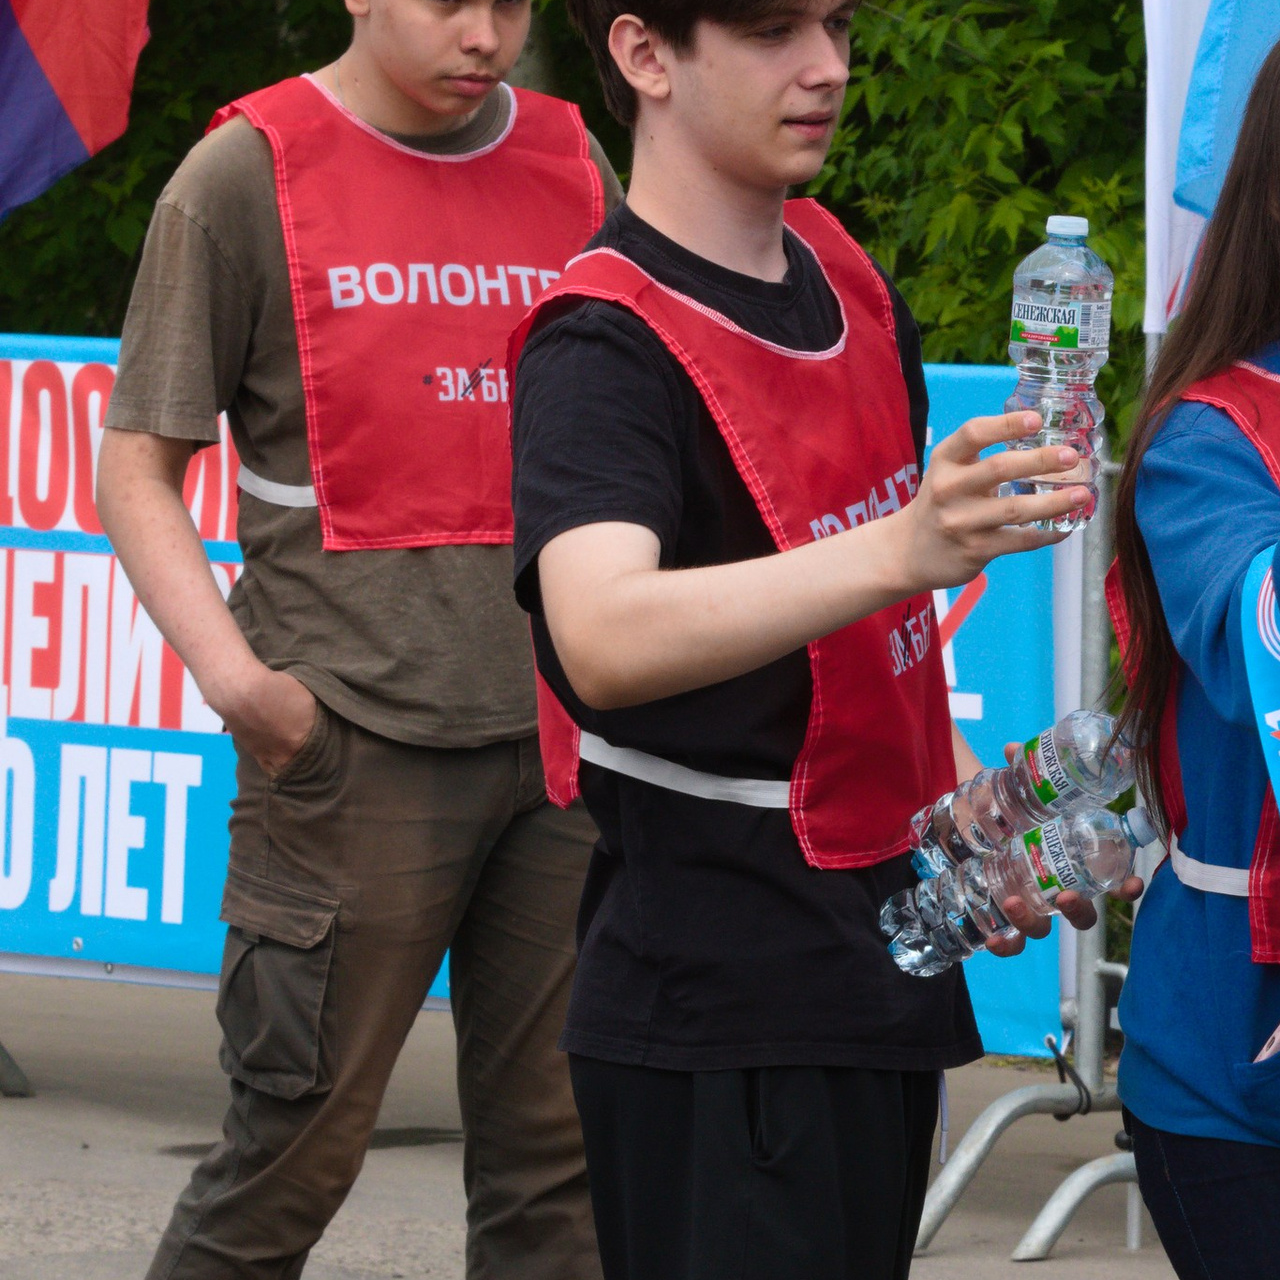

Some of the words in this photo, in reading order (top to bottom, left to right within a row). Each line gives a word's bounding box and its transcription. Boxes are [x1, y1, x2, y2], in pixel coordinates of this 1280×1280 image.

[1013, 302, 1077, 325] СЕНЕЖСКАЯ
[48, 742, 203, 925] ЛЕТ
[1042, 823, 1078, 888] СЕНЕЖСКАЯ
